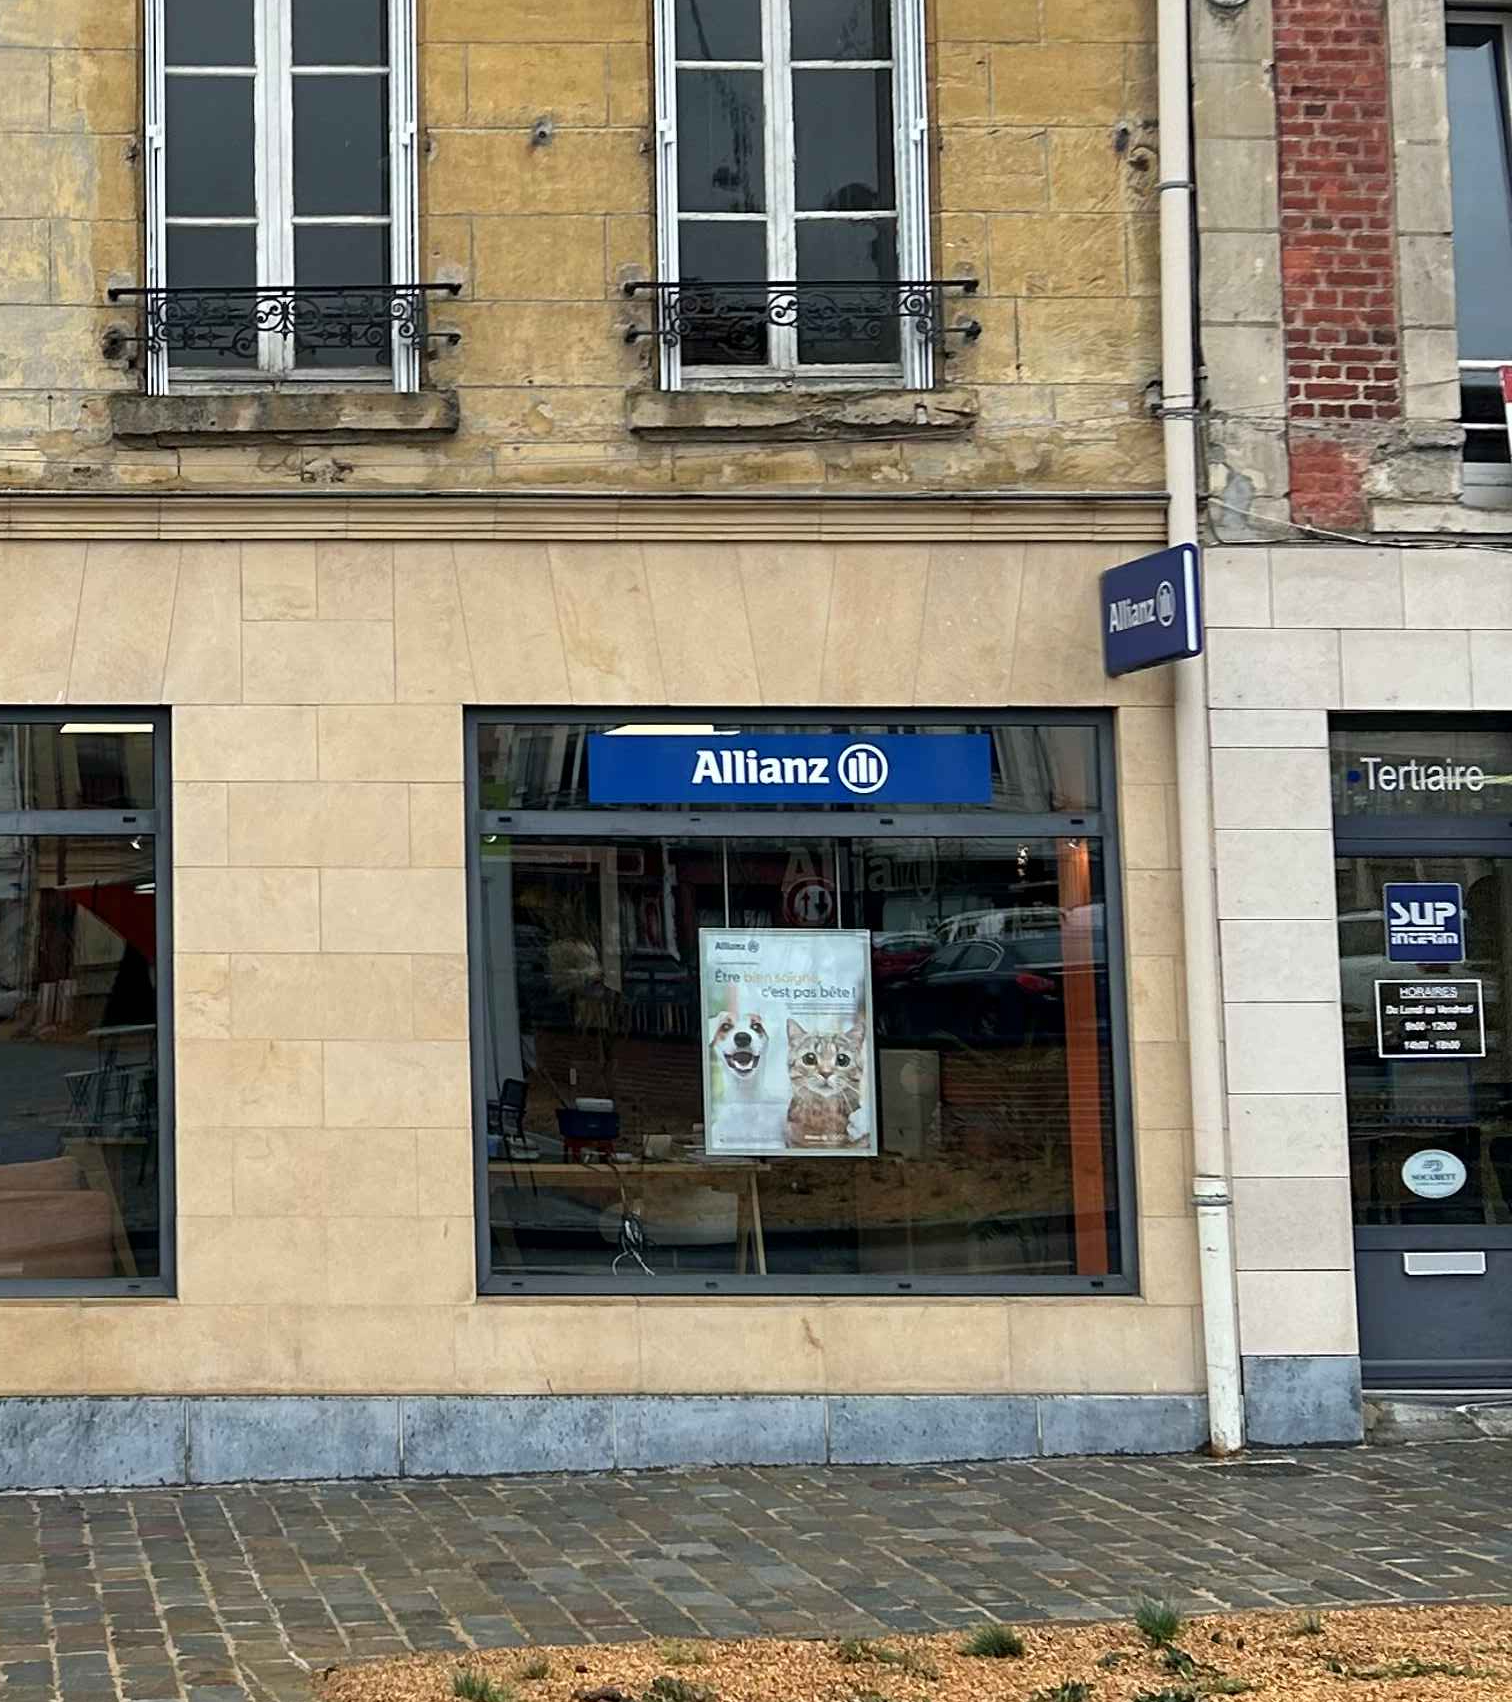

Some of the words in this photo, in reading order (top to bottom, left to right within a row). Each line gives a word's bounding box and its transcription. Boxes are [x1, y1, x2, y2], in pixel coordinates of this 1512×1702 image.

[1109, 598, 1156, 633] Allianz
[692, 749, 830, 784] Allianz
[1360, 757, 1485, 791] Tertiaire
[1390, 902, 1457, 926] SUP
[714, 968, 740, 983] Être
[761, 986, 790, 998] c'est
[793, 987, 816, 999] pas
[819, 985, 850, 998] bête
[1400, 986, 1457, 997] HORAIRES
[1437, 1004, 1474, 1014] Vendredi
